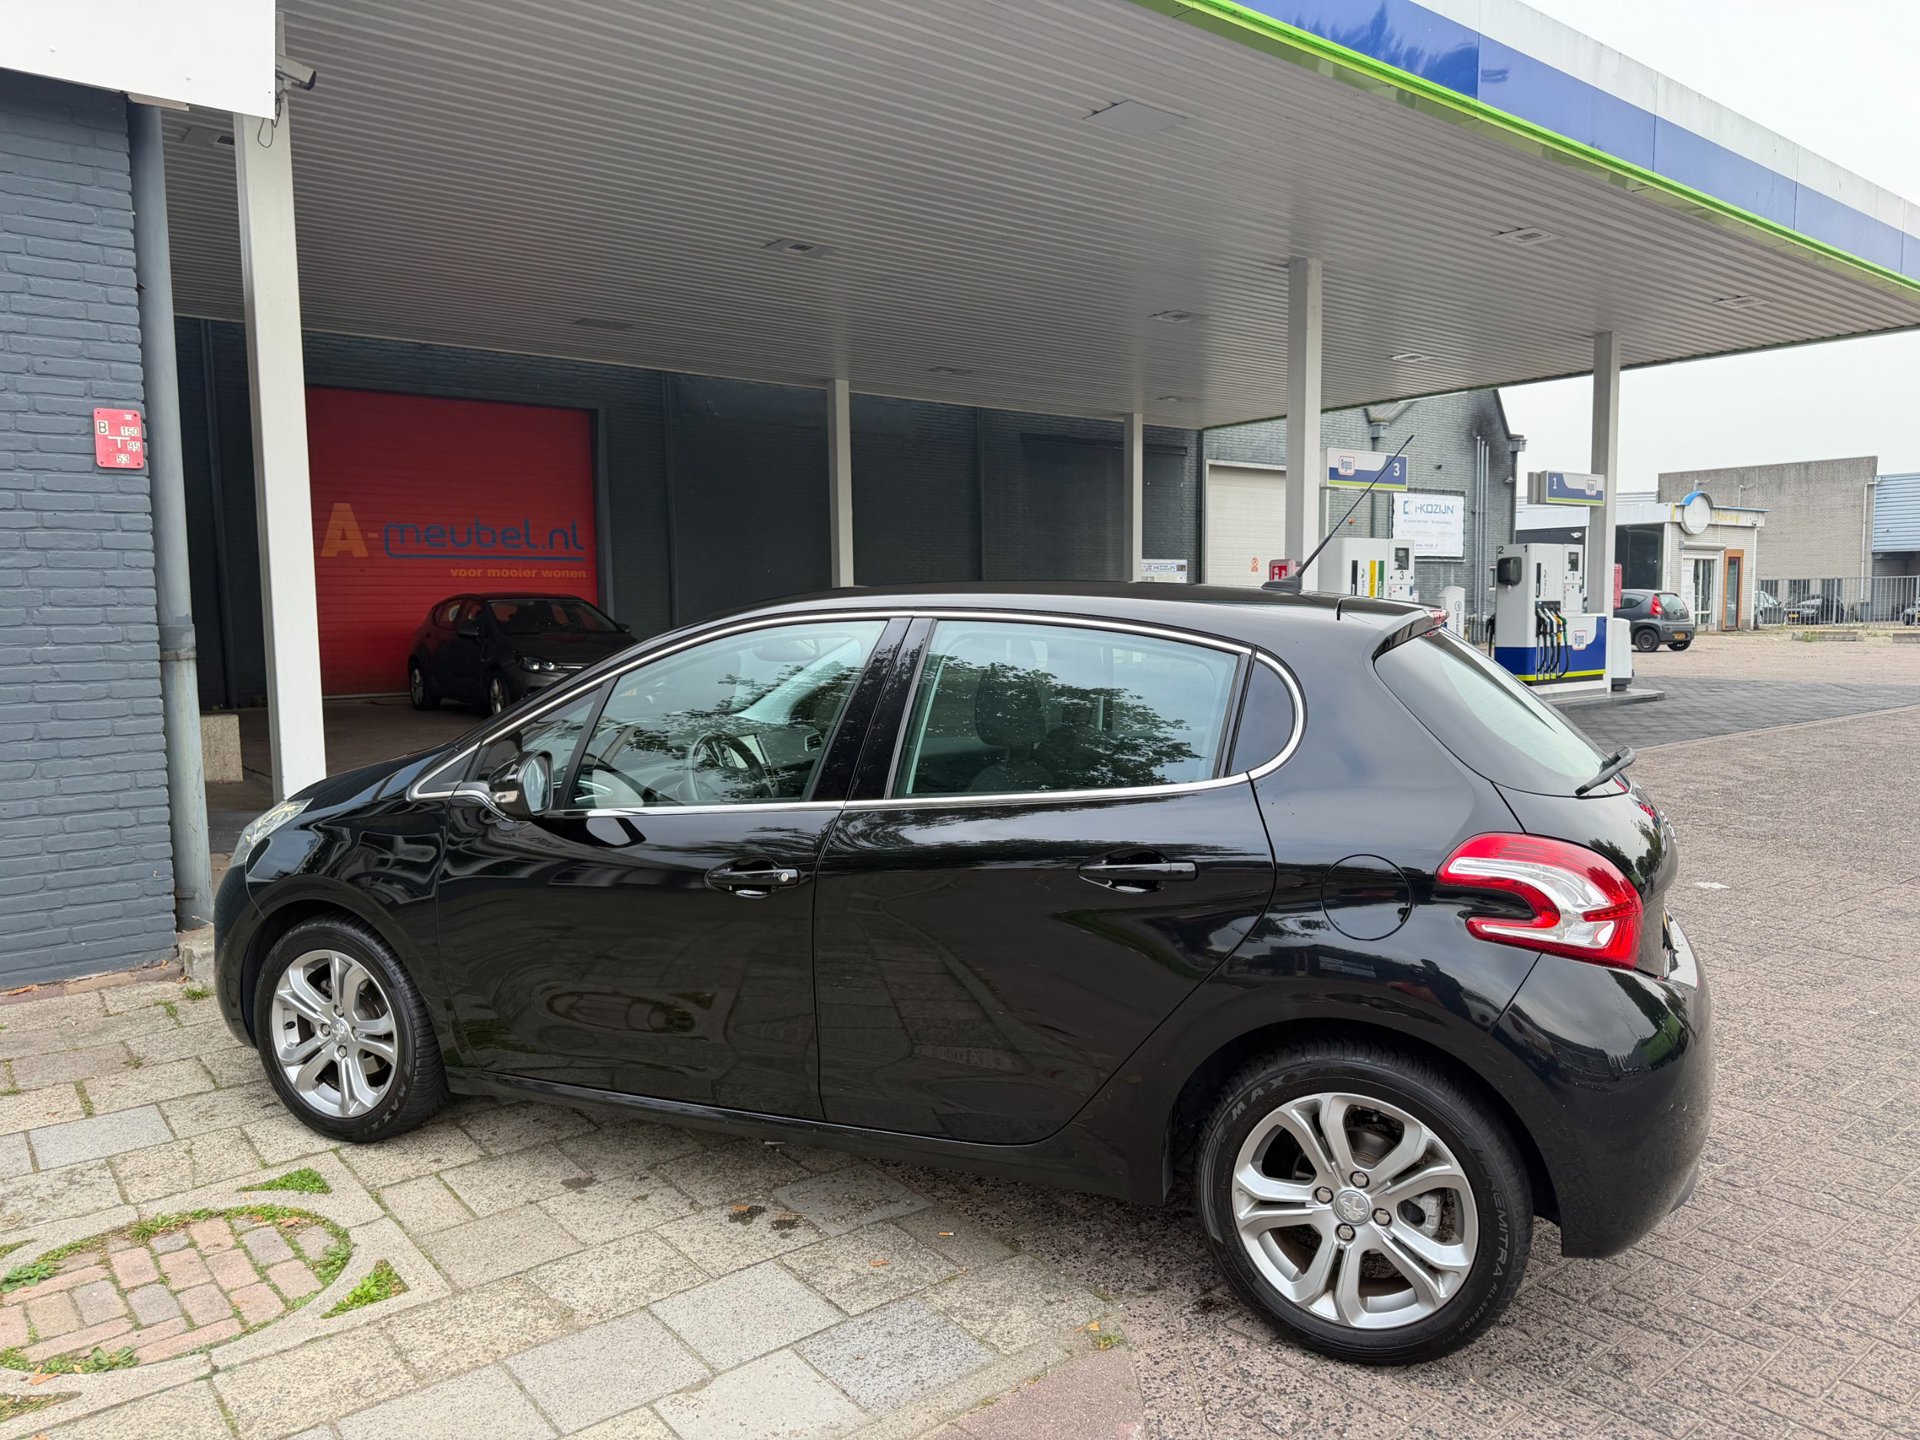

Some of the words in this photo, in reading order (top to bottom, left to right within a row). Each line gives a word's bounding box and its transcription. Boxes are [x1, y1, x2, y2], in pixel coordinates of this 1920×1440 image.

[98, 421, 107, 434] B
[122, 427, 139, 436] 150
[1393, 462, 1400, 477] 3
[1552, 477, 1558, 490] 1
[1498, 545, 1504, 554] 2
[1523, 544, 1528, 553] 1
[450, 567, 483, 578] voor
[487, 566, 536, 578] mooier
[541, 567, 587, 579] wonen
[1399, 570, 1405, 580] 3
